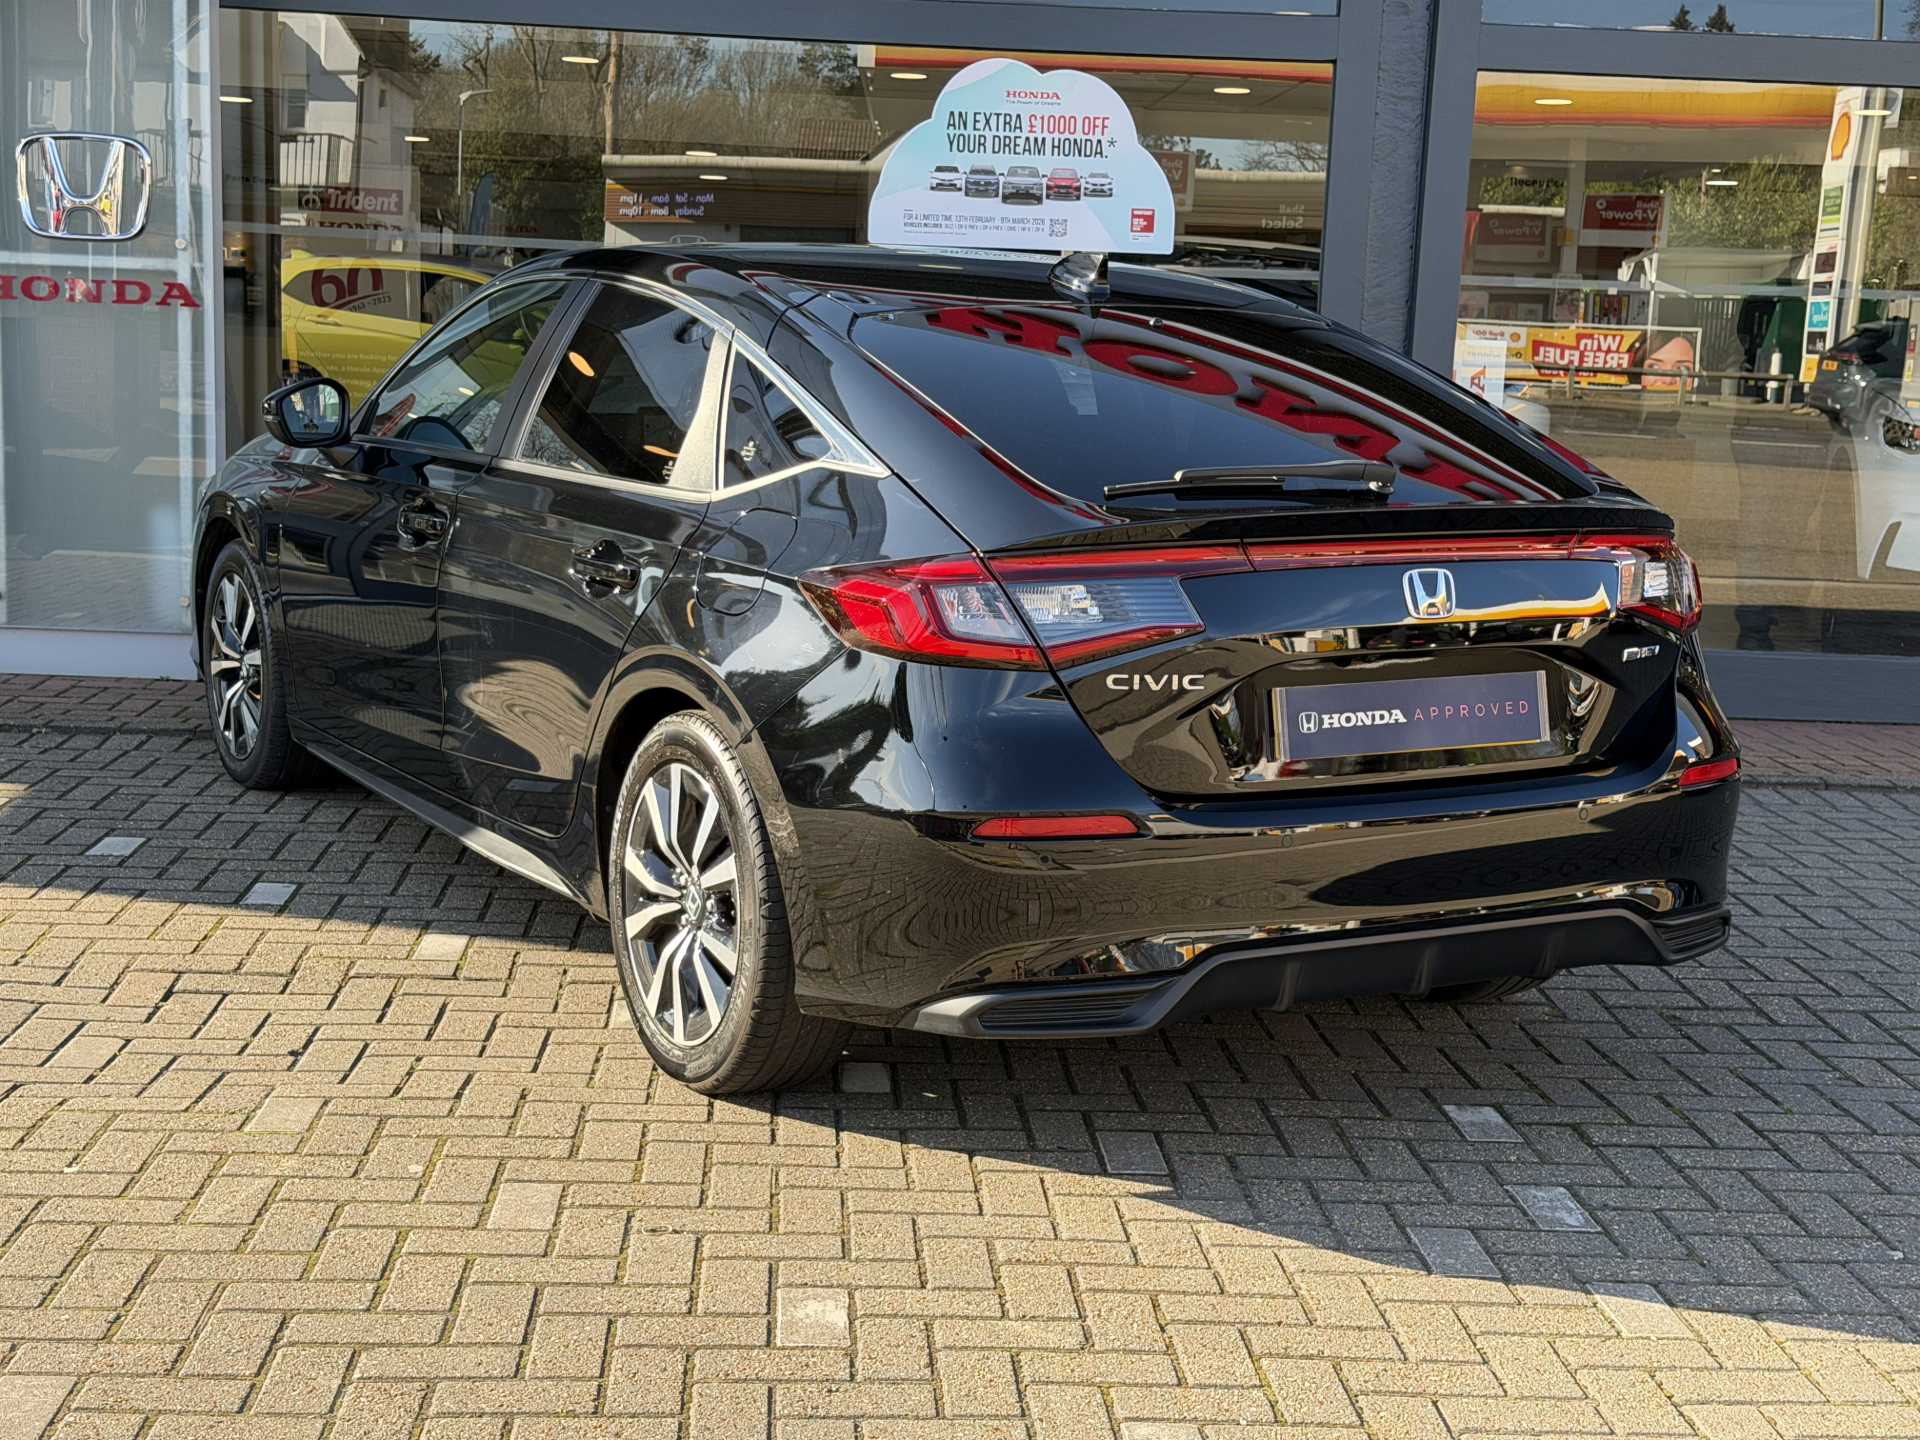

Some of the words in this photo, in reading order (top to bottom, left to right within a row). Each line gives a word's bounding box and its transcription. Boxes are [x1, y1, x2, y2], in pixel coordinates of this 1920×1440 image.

[1006, 90, 1062, 100] HONDA
[946, 111, 968, 131] AN
[972, 112, 1023, 133] EXTRA
[1027, 114, 1077, 135] £1000
[1082, 116, 1110, 136] OFF
[947, 133, 987, 154] YOUR
[992, 135, 1046, 156] DREAM
[327, 188, 400, 212] Trident
[311, 255, 384, 308] 60
[1105, 672, 1207, 691] CIVIC
[1321, 708, 1408, 729] HONDA
[1413, 700, 1530, 722] APPROVED
